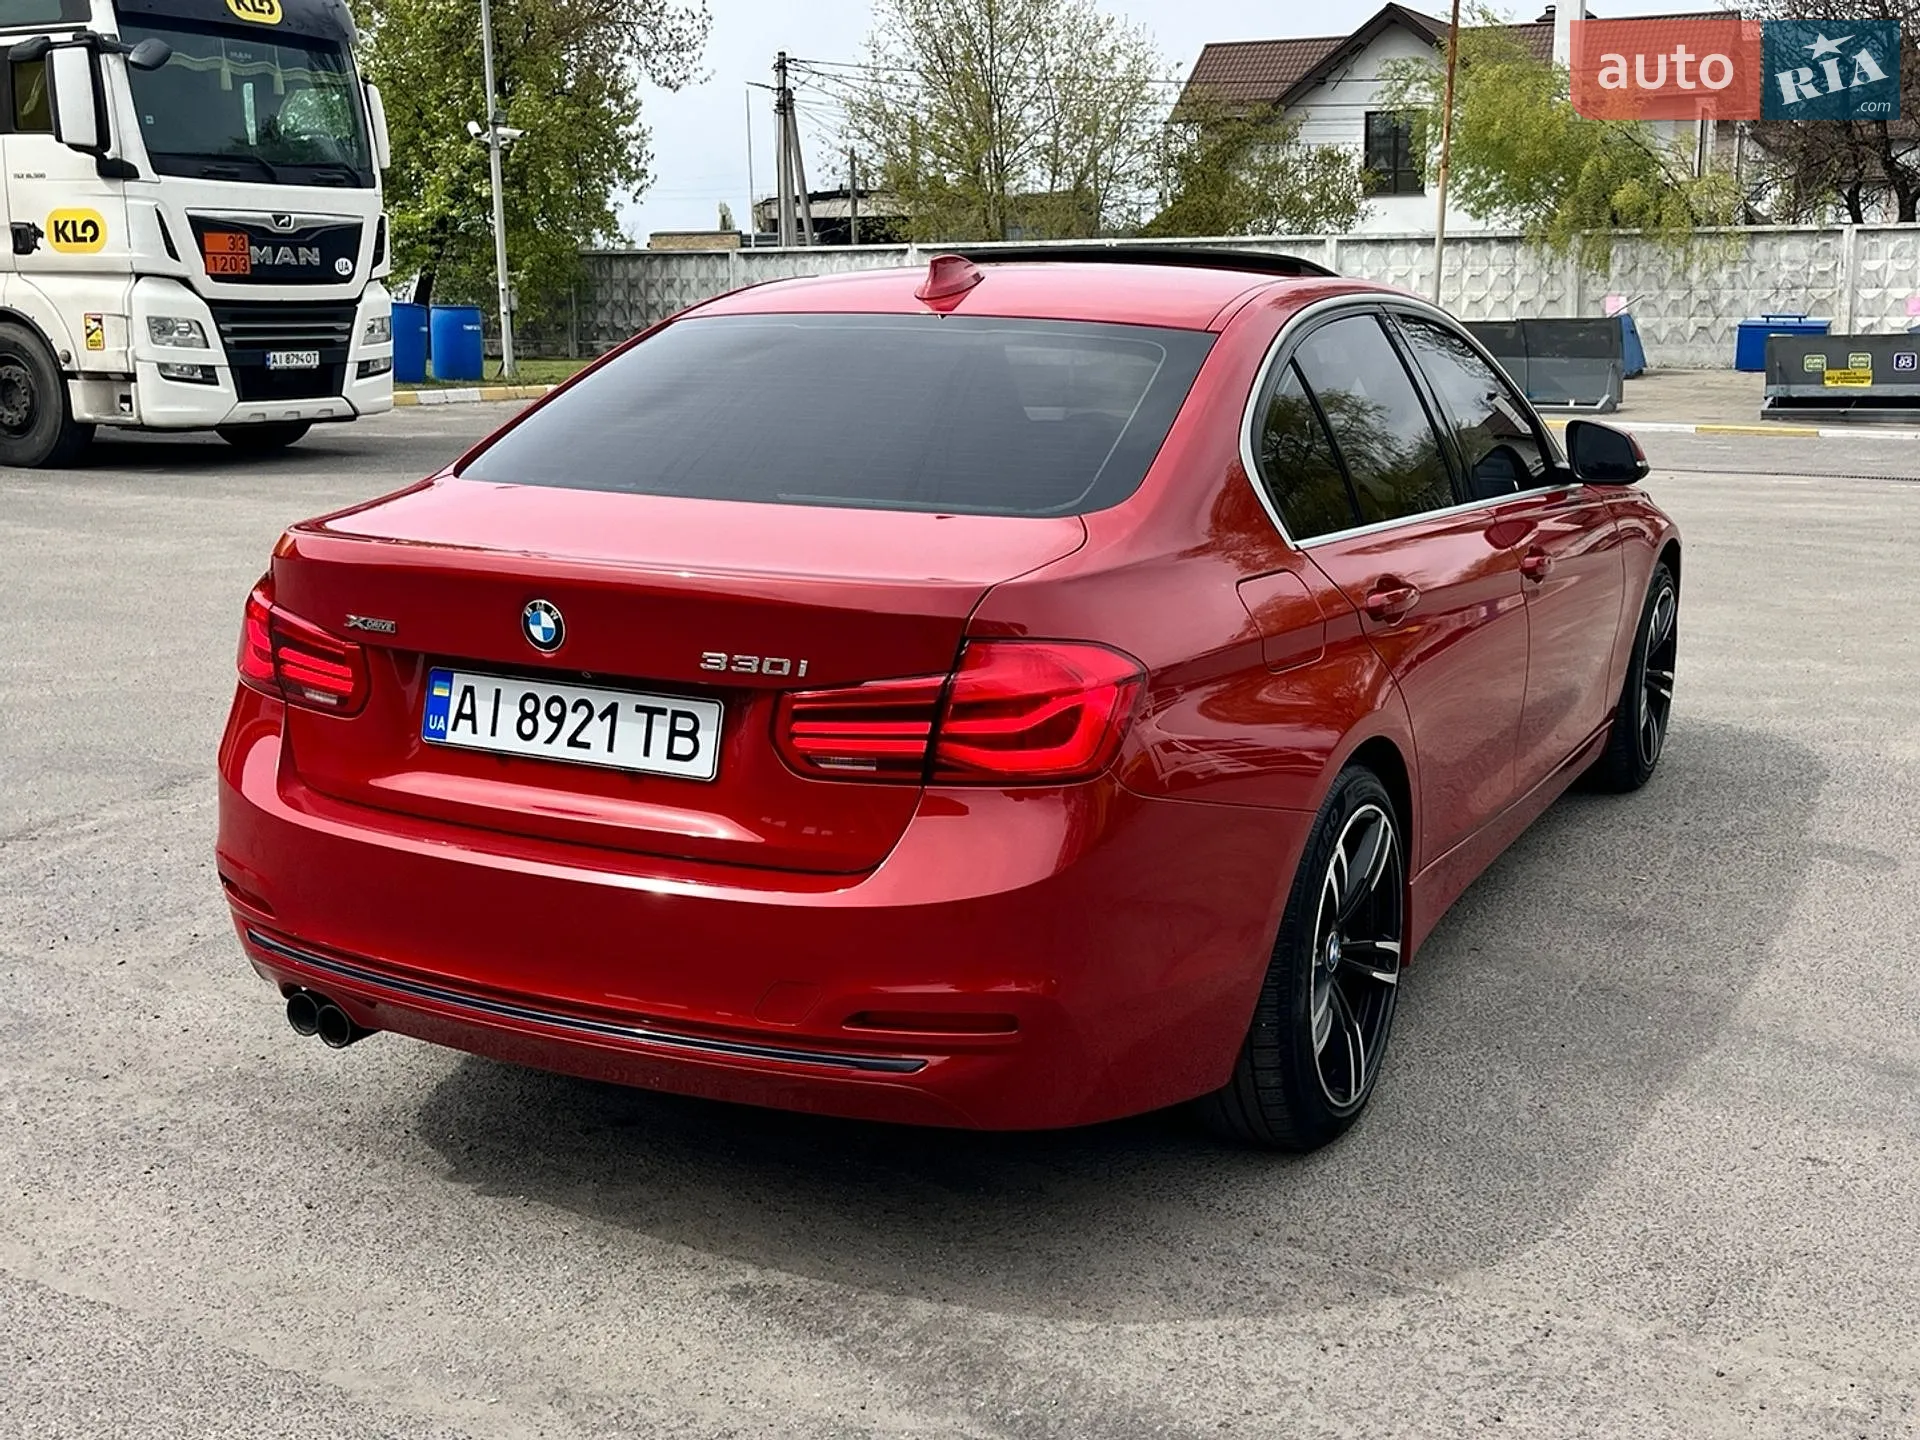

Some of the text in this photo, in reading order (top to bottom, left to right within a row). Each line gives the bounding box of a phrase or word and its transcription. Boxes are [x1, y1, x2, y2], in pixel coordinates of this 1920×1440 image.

[53, 218, 99, 244] KLO
[228, 235, 247, 252] 33
[250, 245, 320, 266] MAN
[211, 256, 248, 273] 1203
[337, 259, 351, 273] UA
[429, 714, 445, 731] UA
[451, 684, 701, 762] AI 8921 TB
